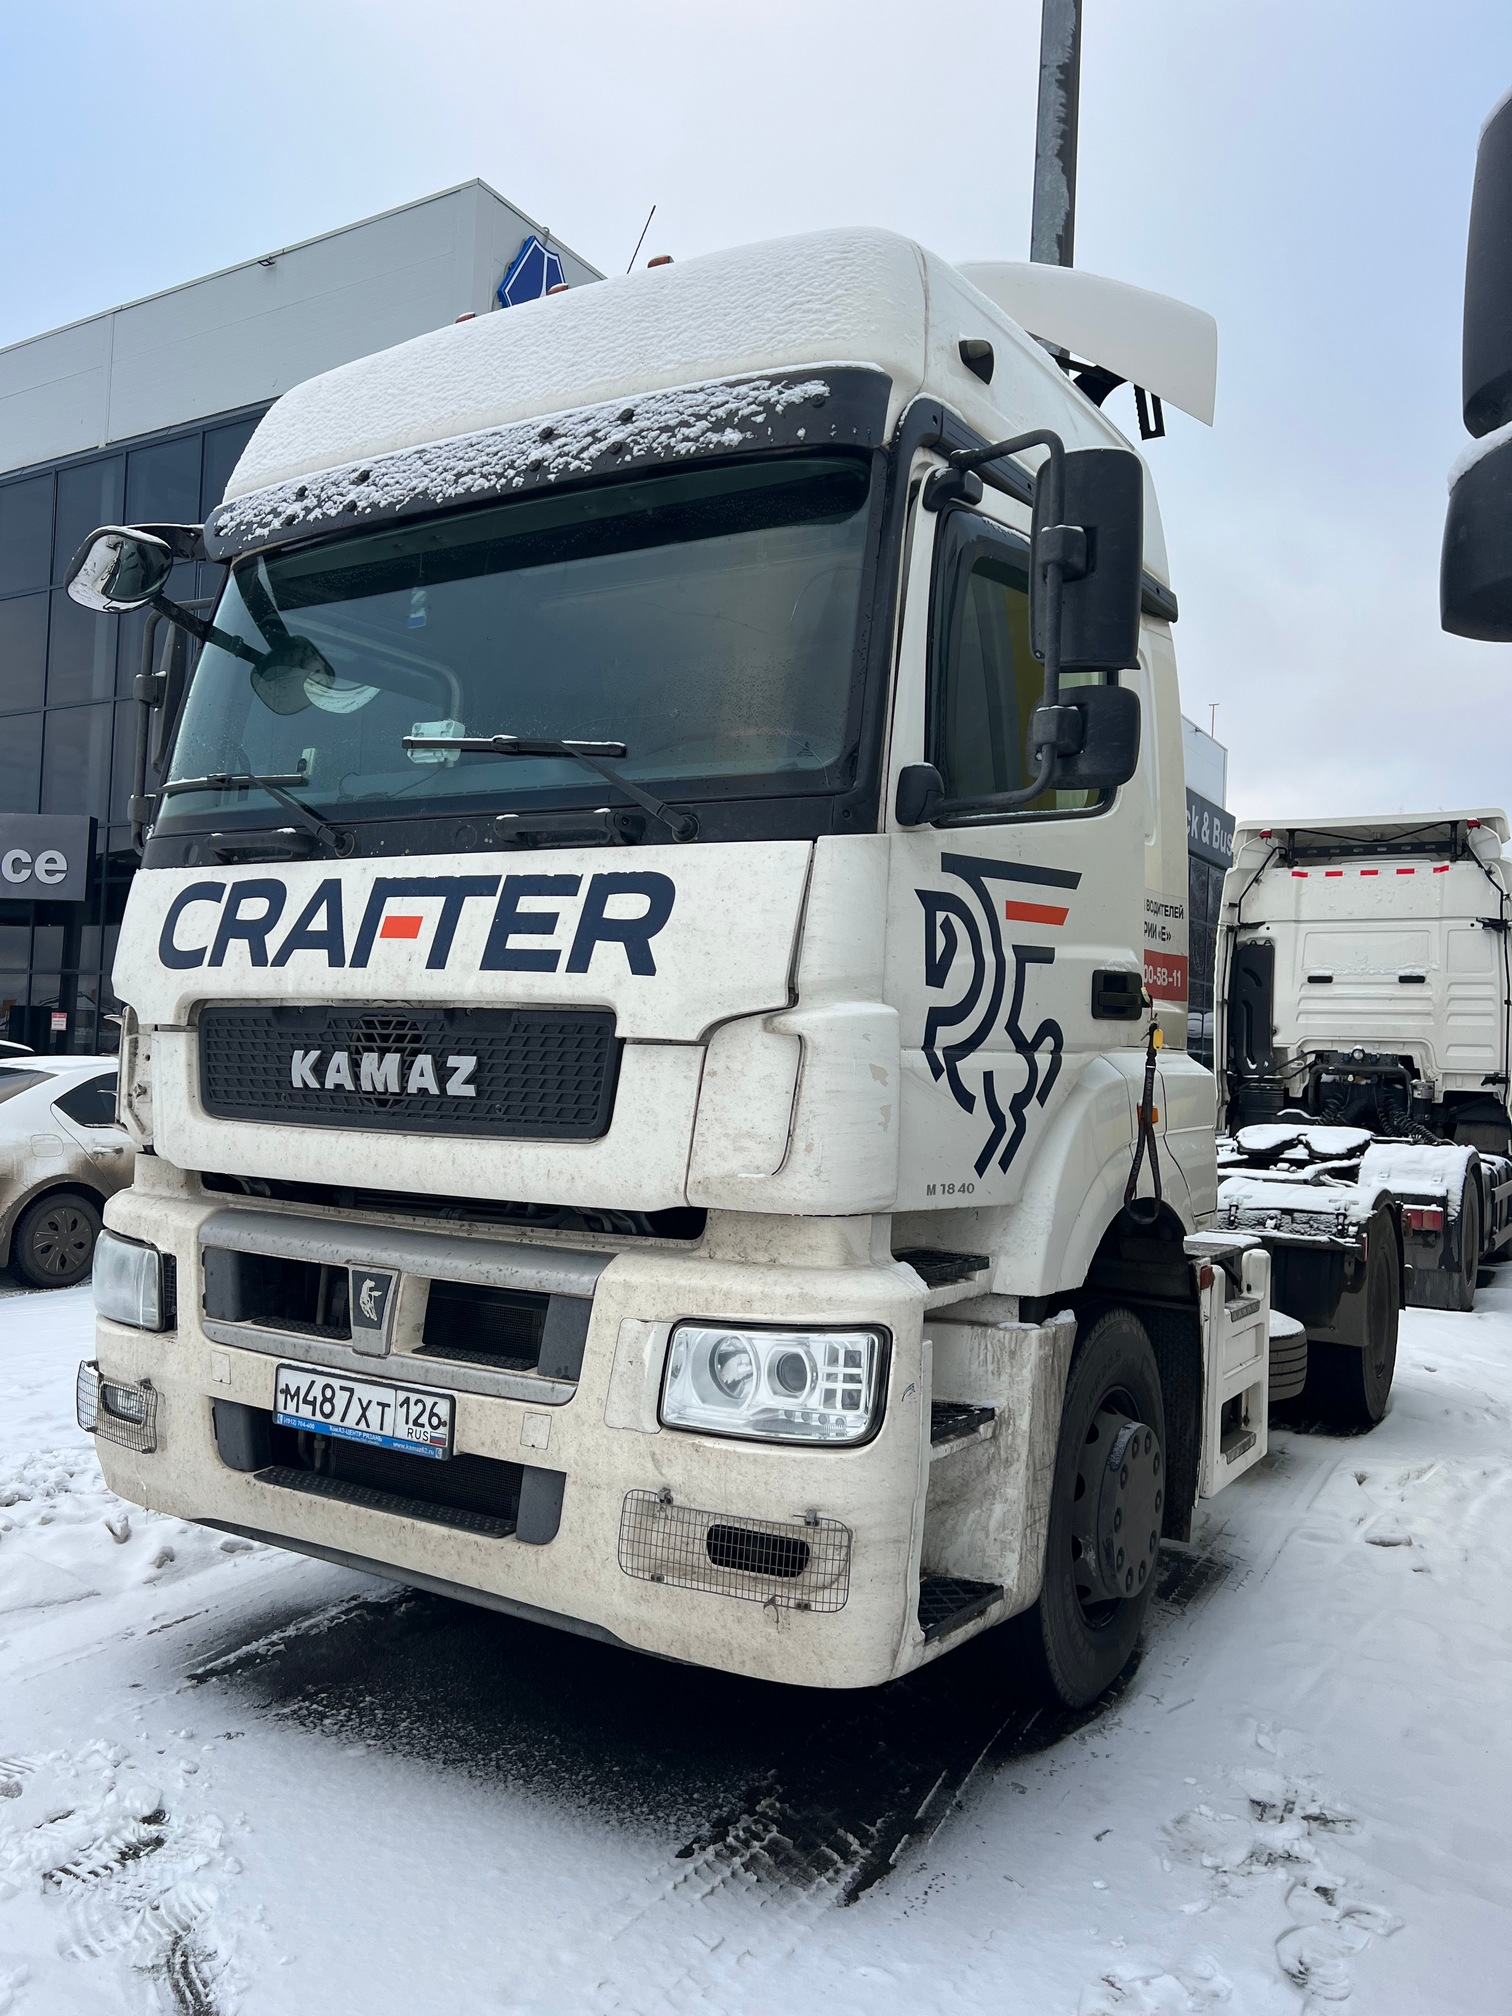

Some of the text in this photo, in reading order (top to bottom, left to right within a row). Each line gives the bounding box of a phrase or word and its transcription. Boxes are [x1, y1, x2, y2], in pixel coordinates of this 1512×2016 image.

[1201, 811, 1210, 845] &
[1212, 816, 1233, 857] Bus
[1, 848, 68, 884] ce
[158, 870, 677, 977] CRAFTER
[1146, 899, 1184, 920] ВОДИТЕЛЕЙ
[290, 1048, 480, 1097] KAMAZ
[926, 1183, 937, 1196] M
[283, 1380, 442, 1431] М487ХТ 126
[407, 1427, 429, 1442] RUS
